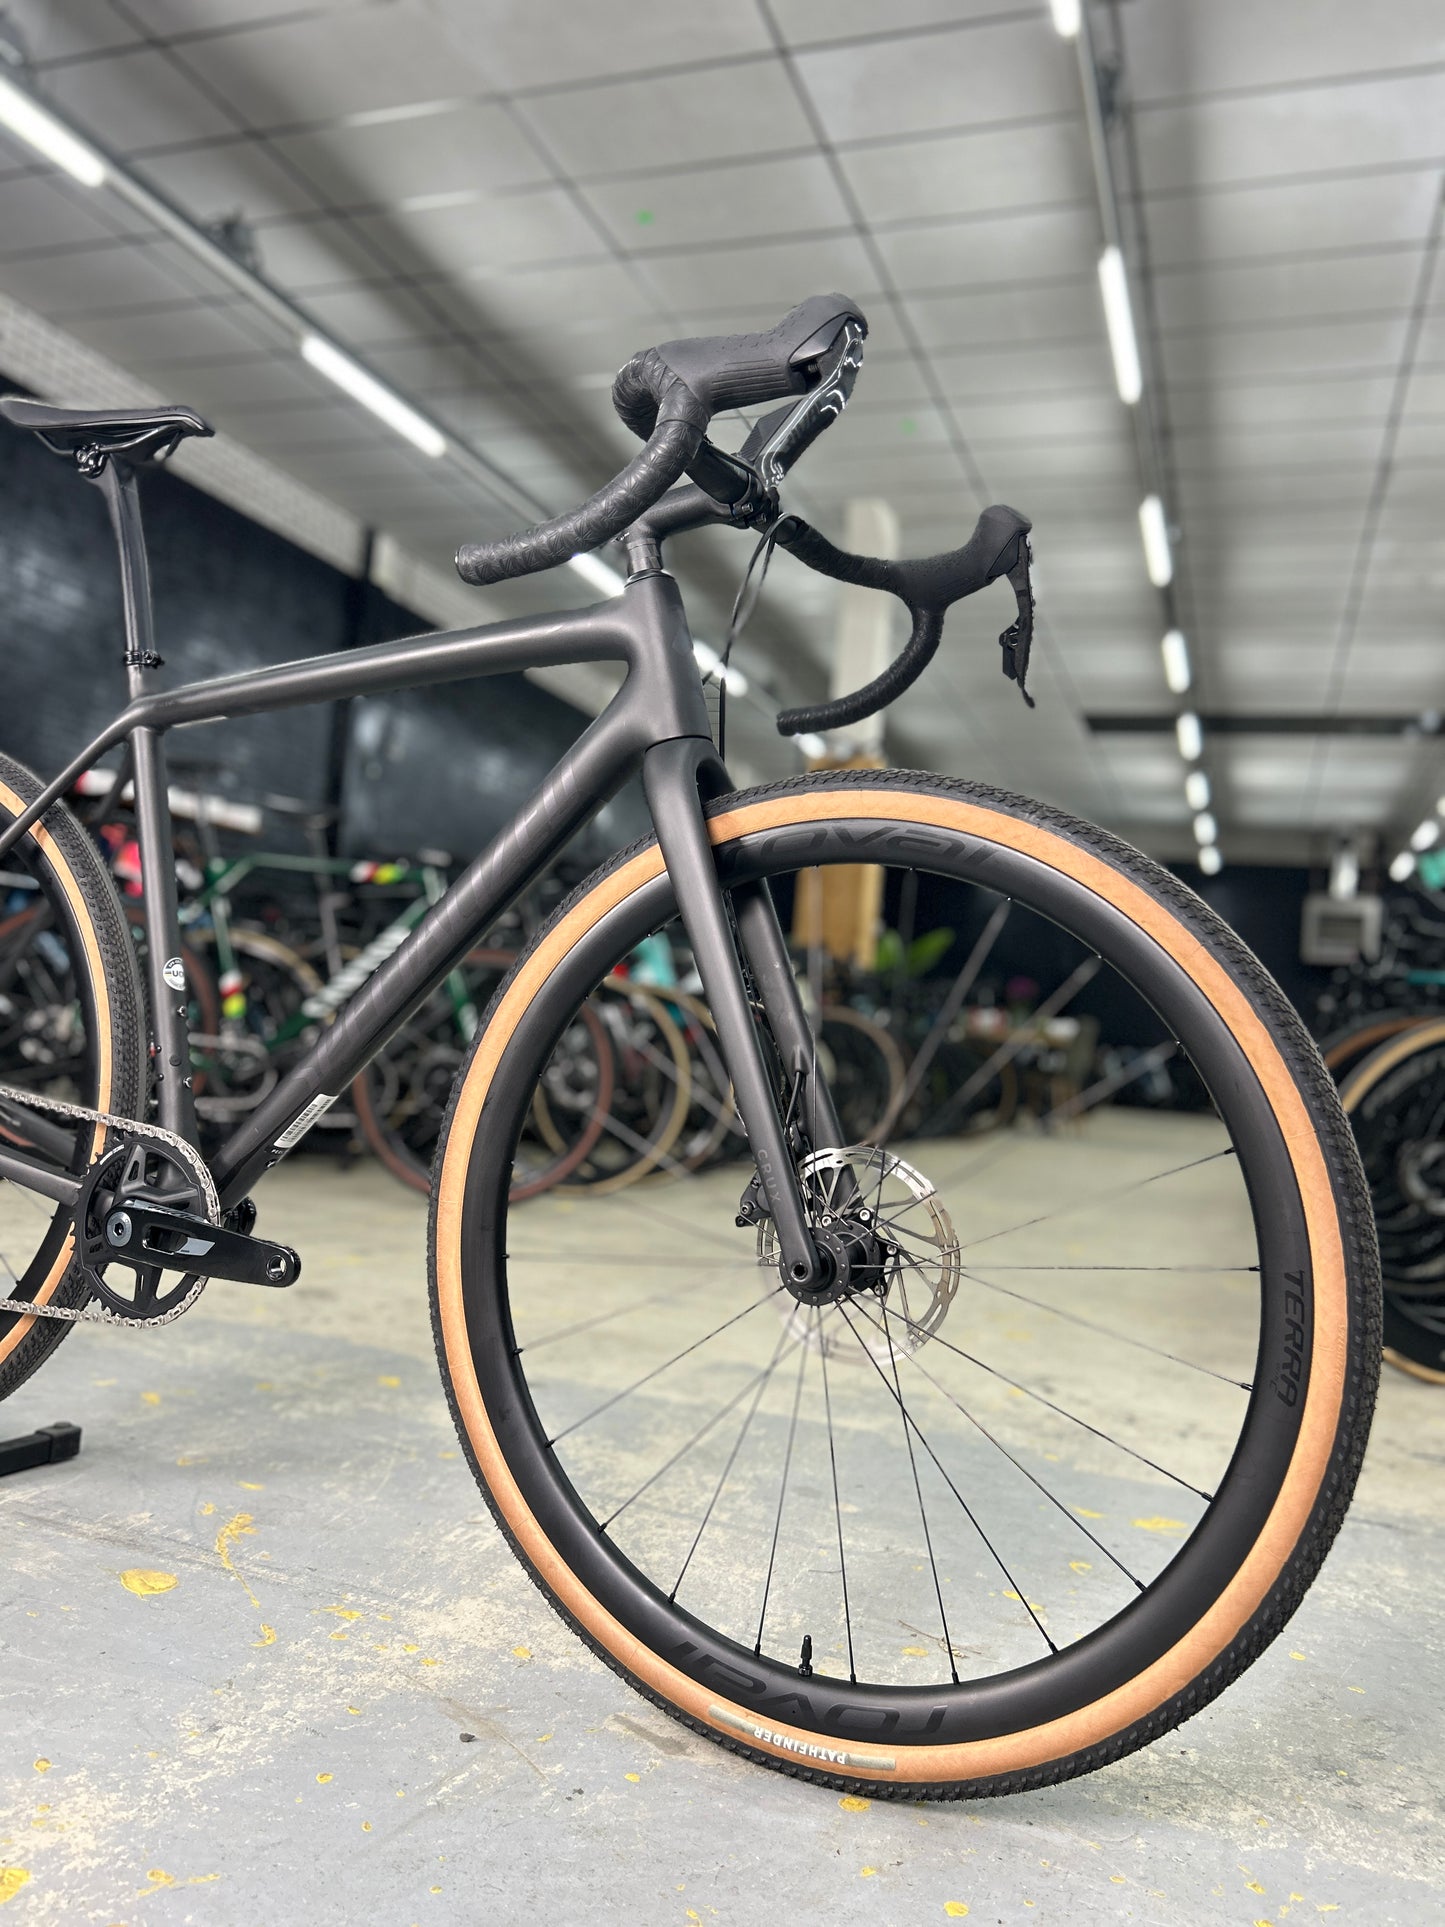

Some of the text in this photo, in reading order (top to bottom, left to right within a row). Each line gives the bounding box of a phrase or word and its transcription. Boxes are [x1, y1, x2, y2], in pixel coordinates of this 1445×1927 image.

[757, 1149, 781, 1201] CRUX
[1276, 1270, 1305, 1407] TERRA
[753, 1727, 847, 1765] PATHFINDER
